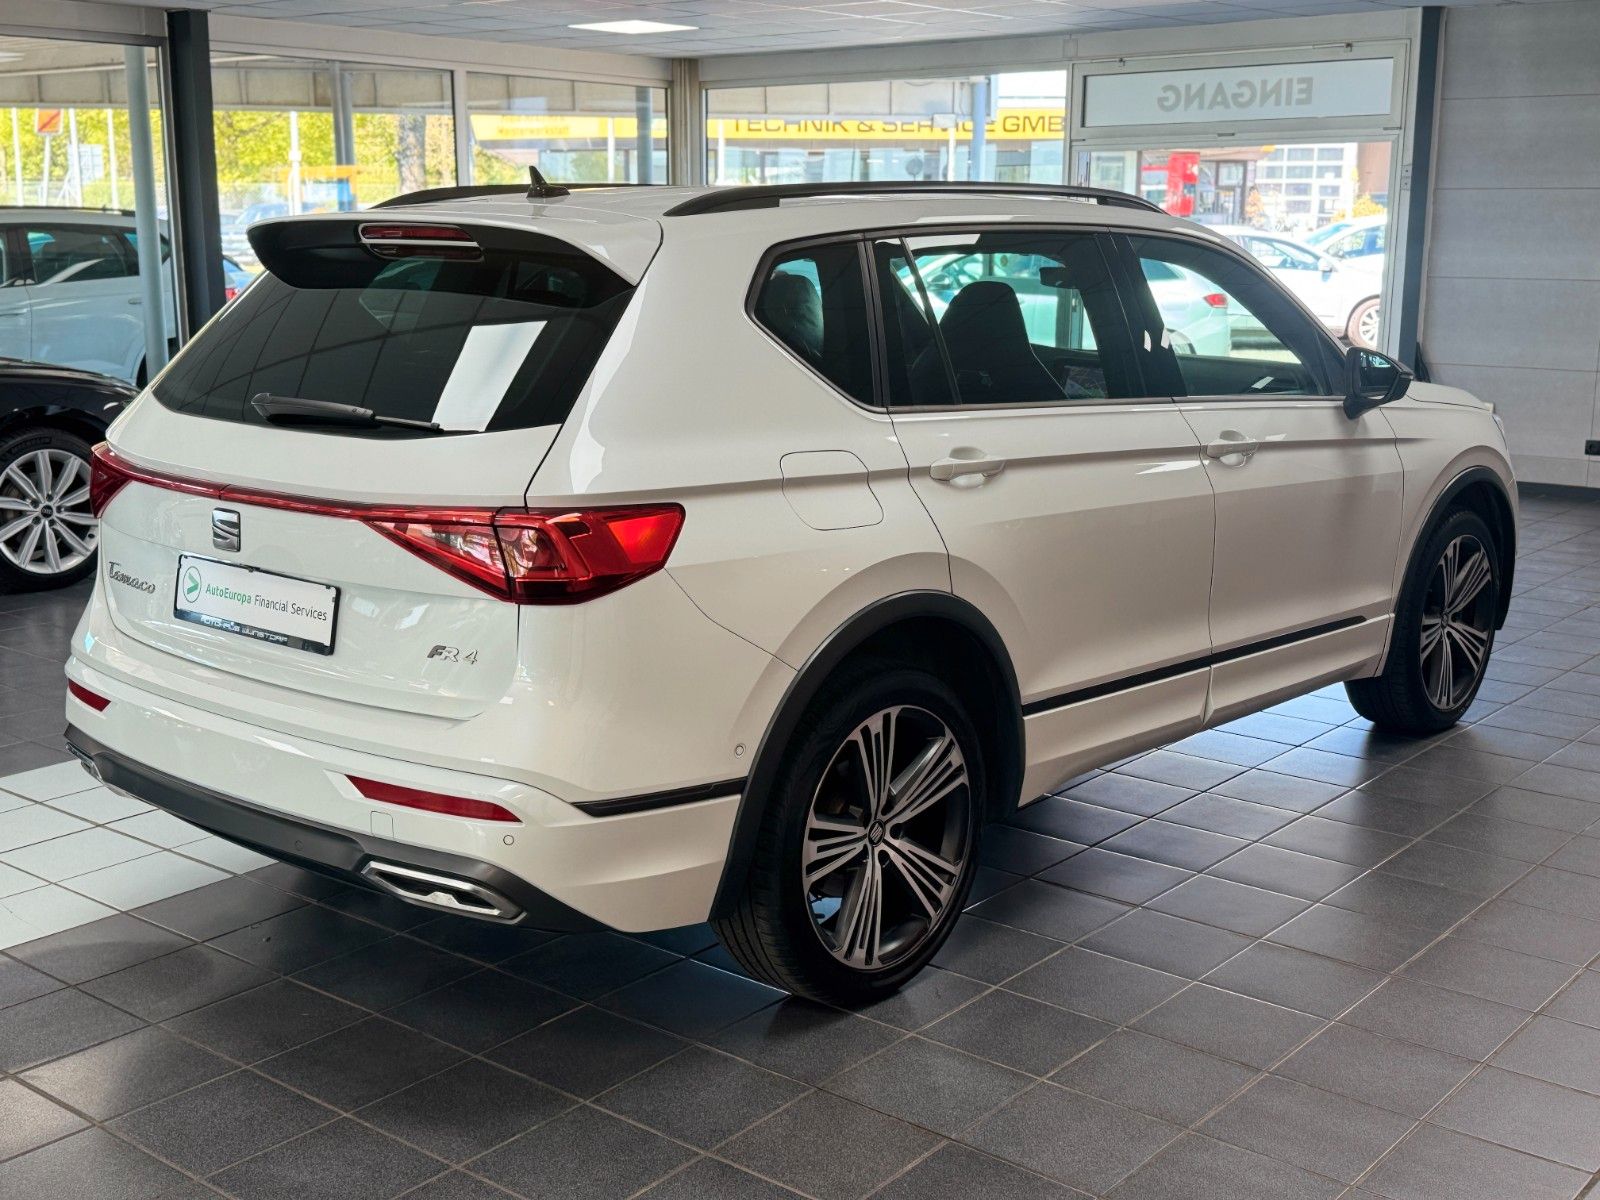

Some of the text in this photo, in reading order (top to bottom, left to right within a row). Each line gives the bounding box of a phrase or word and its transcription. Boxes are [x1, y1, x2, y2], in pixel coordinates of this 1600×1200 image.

[205, 583, 328, 622] AutoEuropa Financial Services
